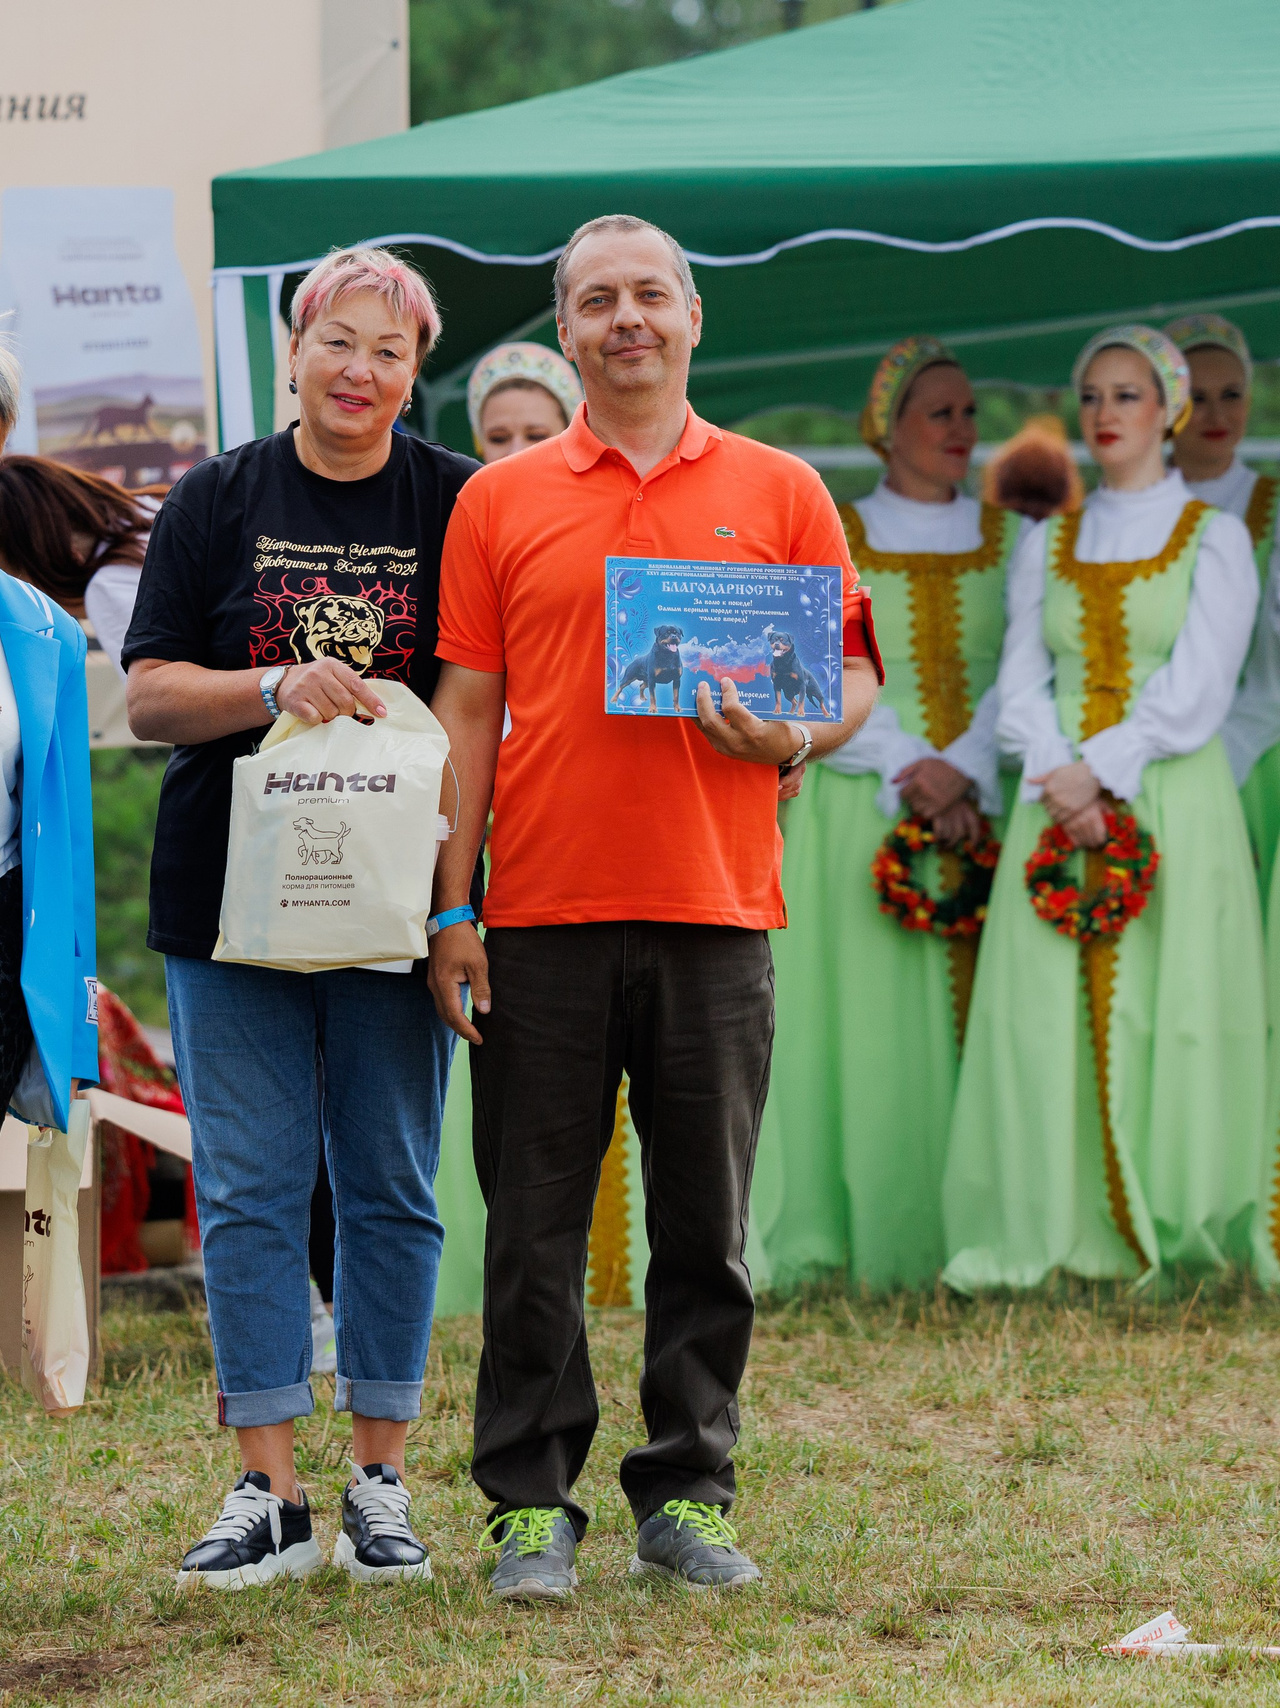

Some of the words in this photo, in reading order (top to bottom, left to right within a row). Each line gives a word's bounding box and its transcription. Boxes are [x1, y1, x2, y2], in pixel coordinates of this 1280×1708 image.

[52, 283, 162, 307] Hanta
[256, 535, 346, 555] Национальный
[349, 543, 417, 560] Чемпионат
[253, 554, 329, 573] Победитель
[334, 558, 378, 576] Клуба
[661, 581, 783, 596] БЛАГОДАРНОСТЬ
[657, 604, 682, 612] Самым
[263, 771, 396, 795] Hanta
[297, 796, 350, 806] premium
[284, 874, 353, 882] Полнорационные
[306, 882, 319, 890] для
[320, 882, 355, 890] питомцев
[291, 899, 351, 907] MYHANTA.COM
